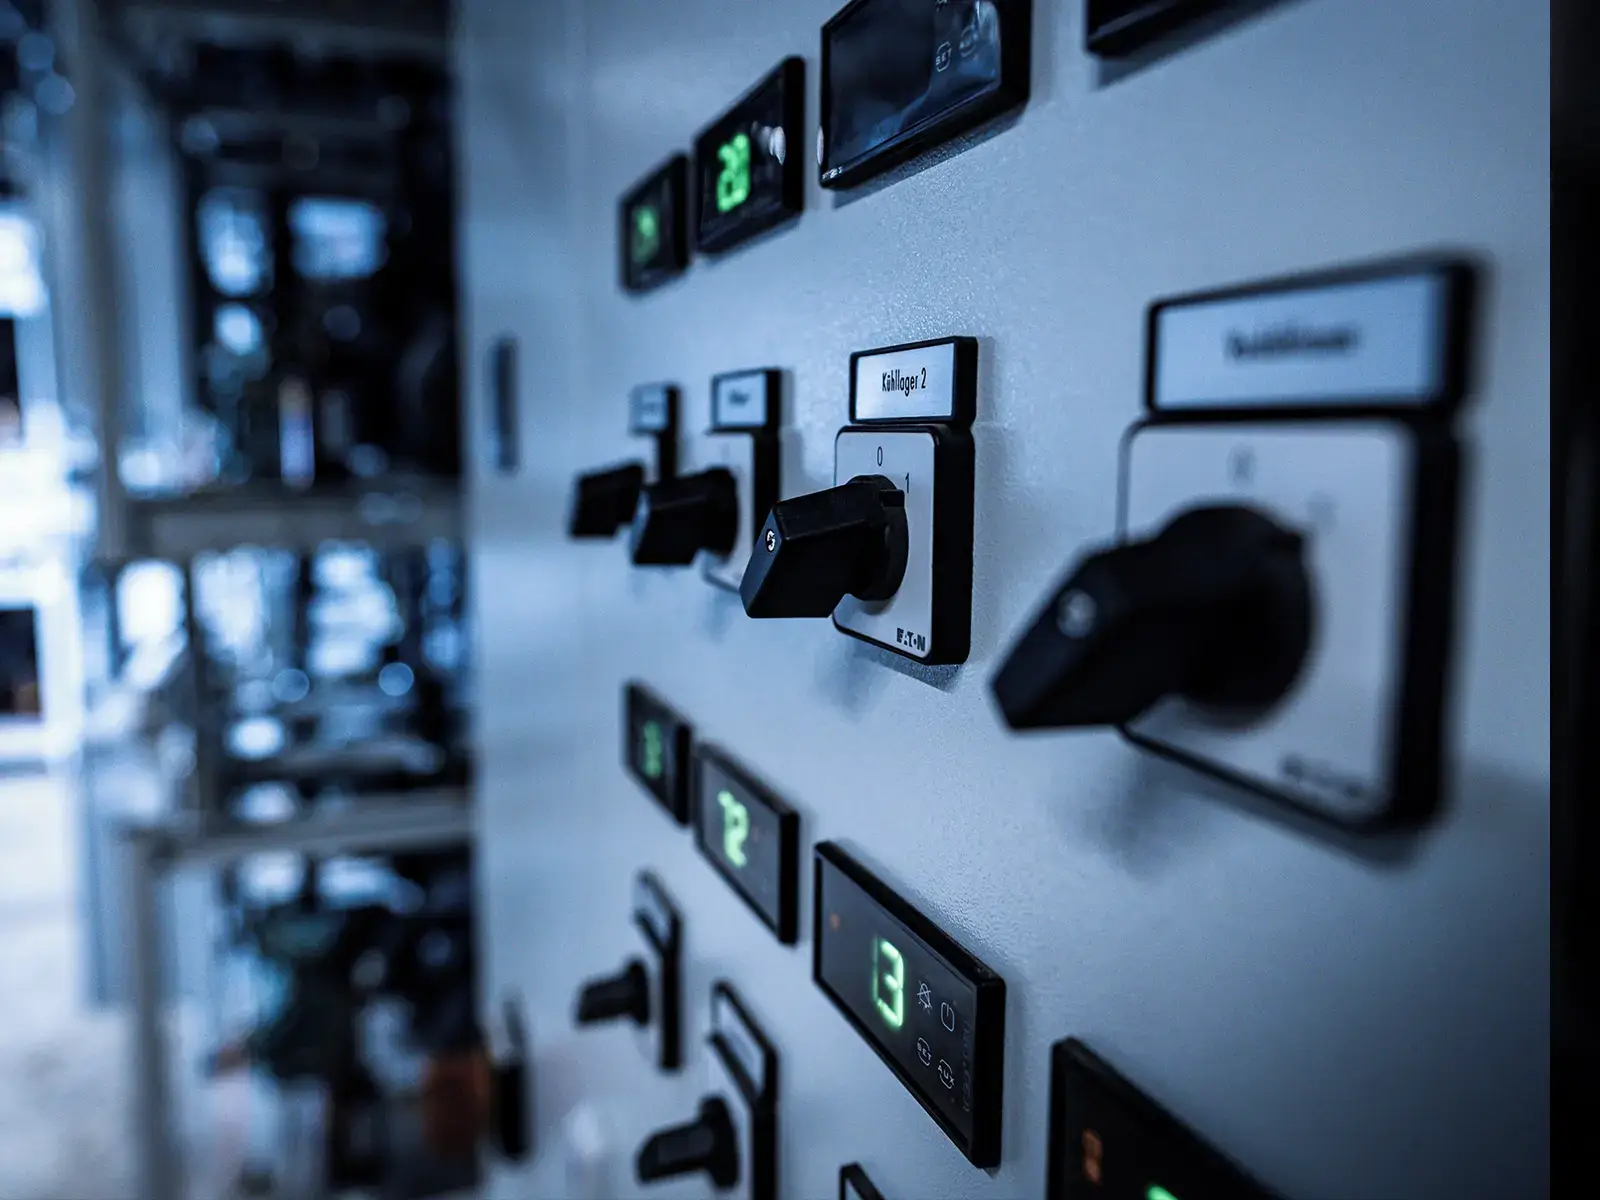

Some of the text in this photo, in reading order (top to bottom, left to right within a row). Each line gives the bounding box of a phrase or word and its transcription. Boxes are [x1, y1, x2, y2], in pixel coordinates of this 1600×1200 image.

[882, 367, 927, 396] Kühllager 2
[876, 446, 883, 467] 0
[904, 472, 910, 494] 1
[896, 627, 926, 652] EATON
[916, 1042, 932, 1061] SET
[937, 1064, 955, 1086] AUX
